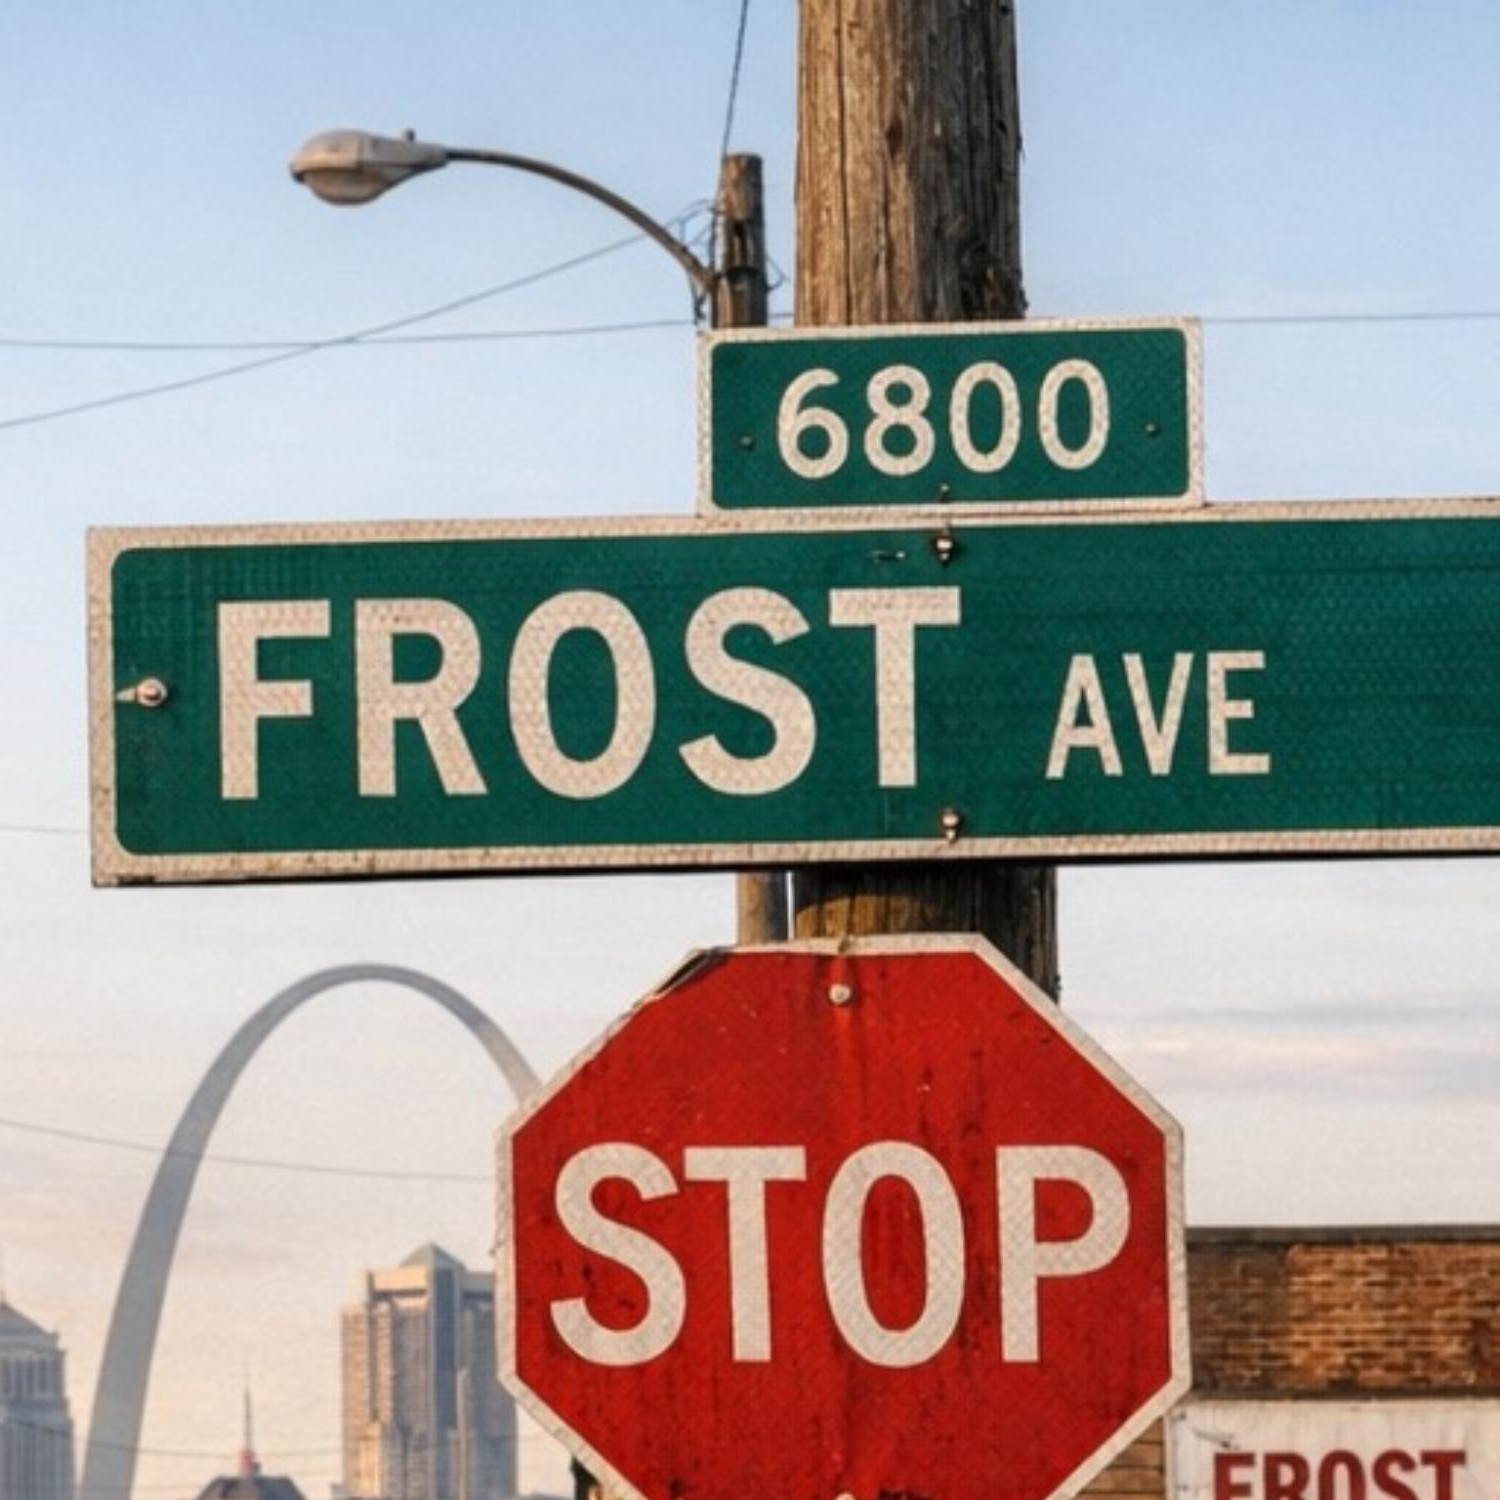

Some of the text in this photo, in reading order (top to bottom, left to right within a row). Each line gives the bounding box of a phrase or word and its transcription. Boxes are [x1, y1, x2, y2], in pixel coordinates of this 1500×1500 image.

[777, 358, 1111, 479] 6800
[217, 585, 1270, 800] FROST AVE
[550, 1140, 1131, 1368] STOP
